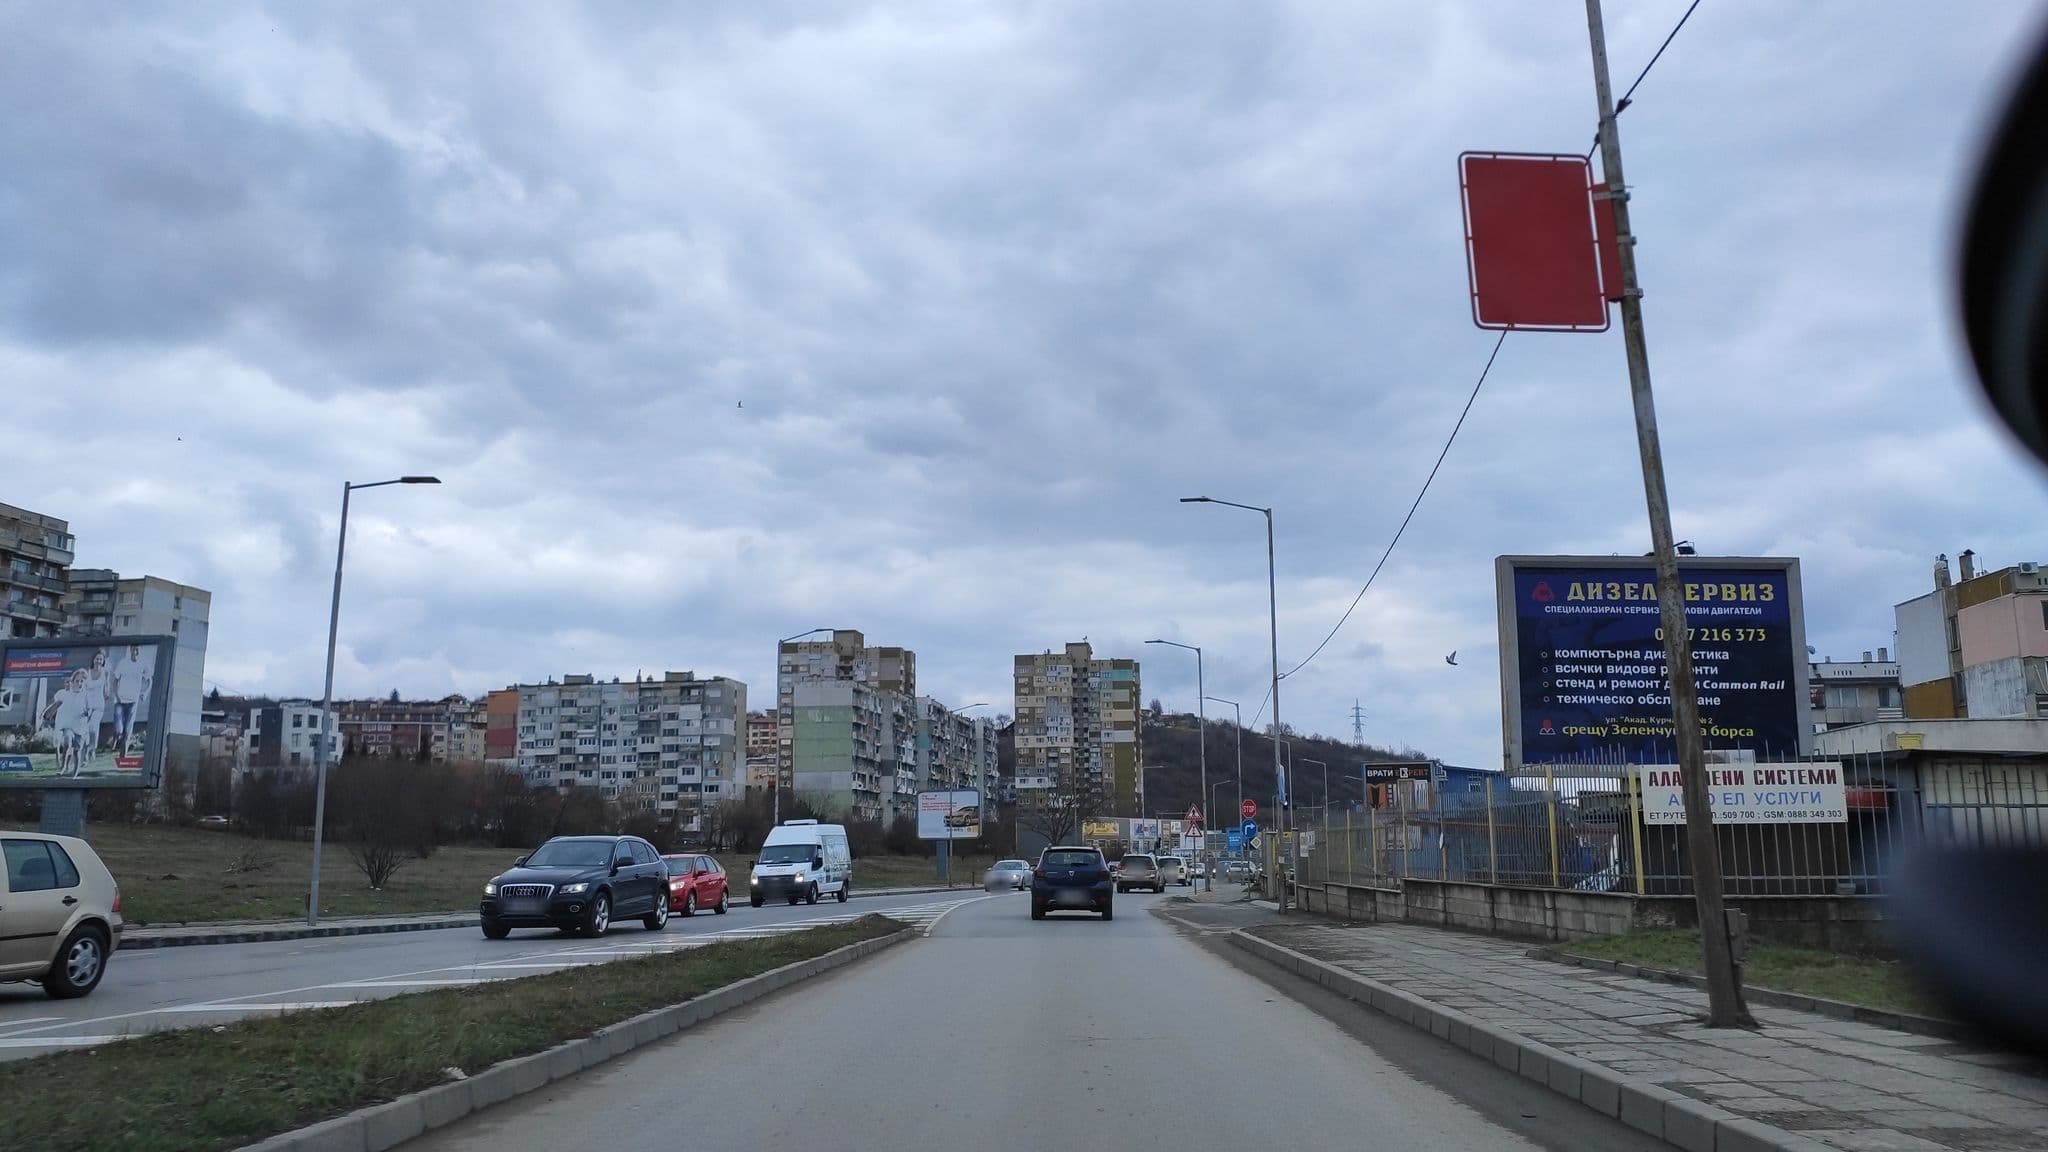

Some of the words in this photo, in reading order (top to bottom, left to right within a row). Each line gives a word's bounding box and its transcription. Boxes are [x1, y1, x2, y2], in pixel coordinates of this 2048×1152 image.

[1567, 582, 1657, 601] ДИЗЕЛ
[1684, 583, 1774, 601] ЕРВИЗ
[1544, 605, 1622, 615] СПЕЦИАЛИЗИРАН
[1624, 606, 1660, 615] СЕРВИЗ
[1711, 606, 1762, 615] ДВИГАТЕЛИ
[1654, 628, 1696, 641] 07
[1700, 628, 1732, 641] 216
[1735, 628, 1766, 641] 373
[1555, 649, 1640, 661] компютърна
[1644, 650, 1730, 660] диастика
[1555, 664, 1602, 674] всички
[1606, 665, 1657, 676] видове
[1661, 666, 1719, 677] рнти
[1556, 679, 1596, 689] стенд
[1599, 680, 1607, 688] и
[1611, 680, 1661, 690] ремонт
[1703, 680, 1757, 689] Common
[1760, 680, 1785, 690] Rail
[1557, 695, 1634, 705] техническо
[1638, 693, 1721, 705] обслане
[1562, 725, 1608, 738] срещу
[1612, 724, 1707, 738] Зеленчуа
[1710, 725, 1754, 739] борса
[1367, 769, 1394, 777] ВРАТИ
[1649, 770, 1745, 787] АЛАЕНИ
[1753, 769, 1837, 786] СИСТЕМИ
[1723, 792, 1745, 806] ЕЛ
[1754, 791, 1822, 806] УСЛУГИ
[1243, 805, 1255, 813] STOP
[1649, 812, 1661, 820] ЕТ
[1740, 811, 1755, 819] 700
[1810, 810, 1825, 818] 349
[1827, 810, 1843, 818] 303
